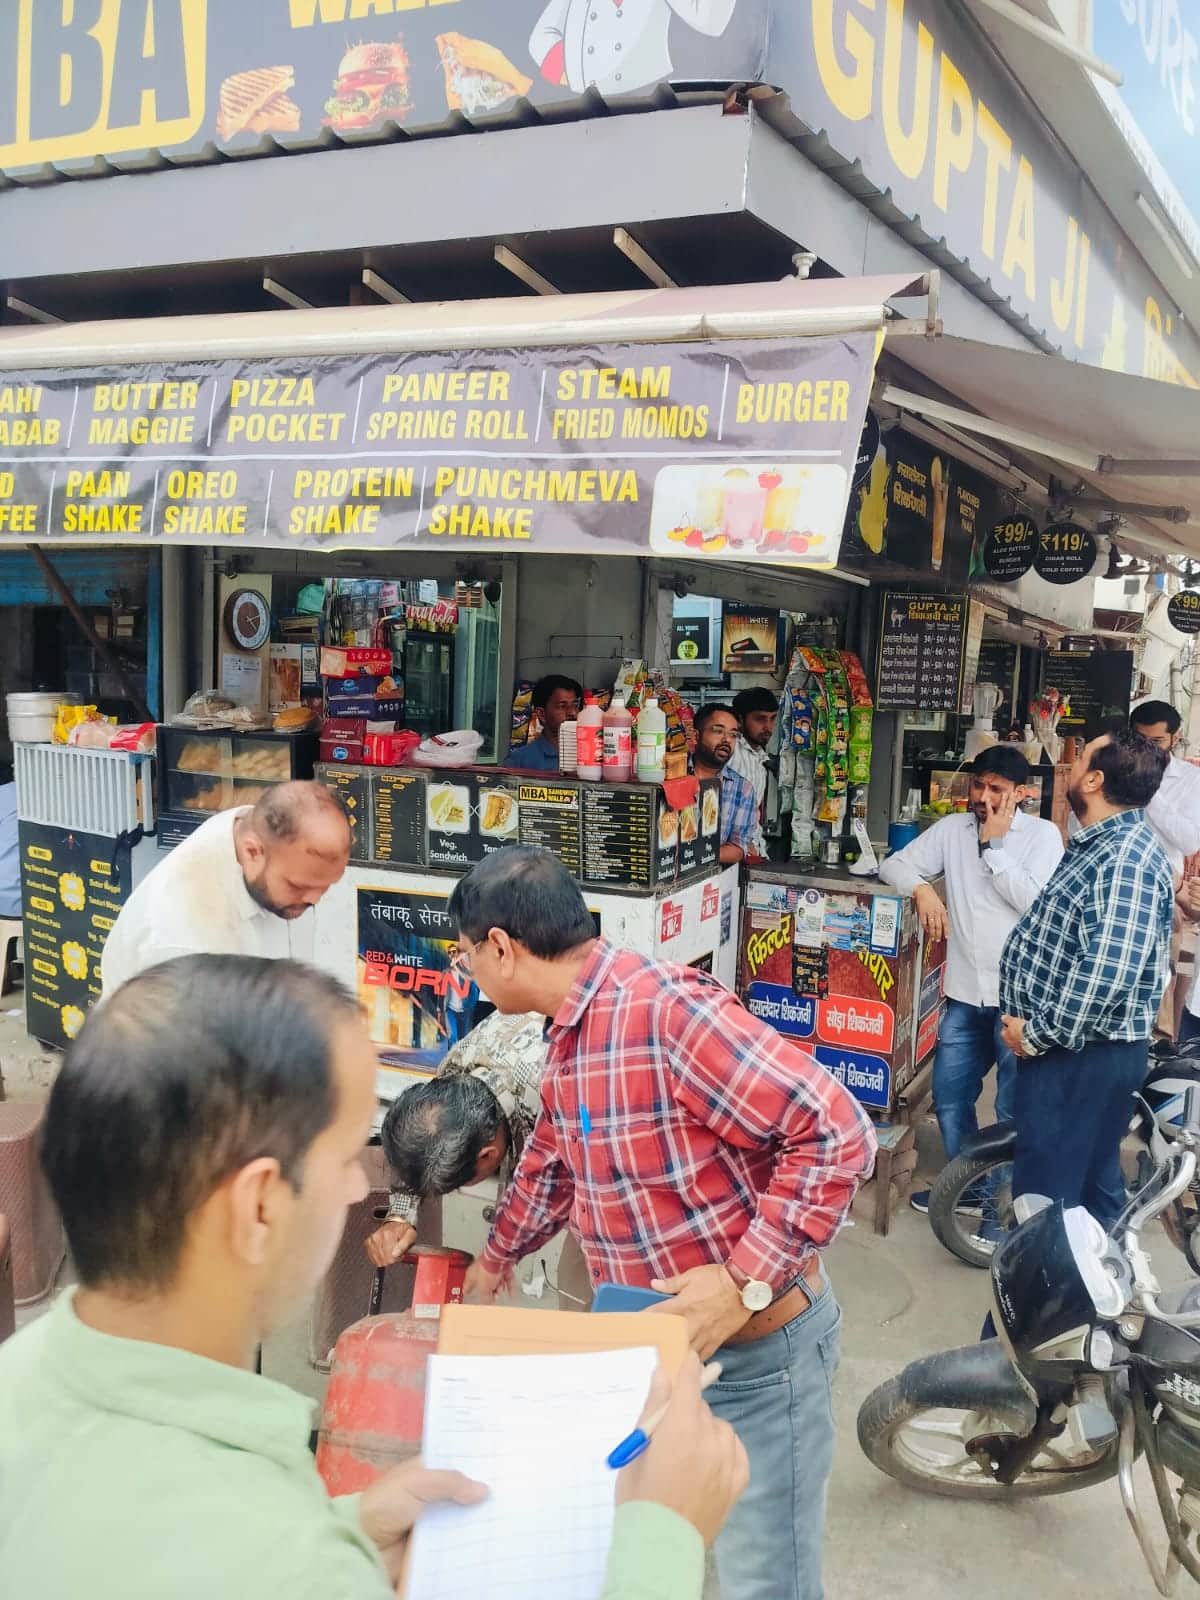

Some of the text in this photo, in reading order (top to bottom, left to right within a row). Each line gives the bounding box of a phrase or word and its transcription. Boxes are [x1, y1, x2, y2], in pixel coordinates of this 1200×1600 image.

[812, 0, 1036, 301] GUPTA
[1051, 216, 1090, 349] JI
[93, 382, 199, 412] BUTTER
[230, 378, 315, 408] PIZZA
[382, 370, 511, 403] PANEER
[557, 366, 671, 401] STEAM
[736, 380, 849, 423] BURGER
[88, 416, 195, 445] MAGGIE
[227, 413, 346, 443] POCKET
[366, 409, 529, 440] SPRING ROLL
[552, 404, 710, 440] FRIED MOMOS
[66, 470, 131, 498] PAAN
[167, 470, 237, 499] OREO
[293, 467, 414, 499] PROTEIN
[434, 467, 639, 502] PUNCHMEVA
[63, 504, 143, 533] SHAKE
[163, 506, 247, 534] SHAKE
[288, 505, 381, 535] SHAKE
[428, 504, 534, 539] SHAKE
[993, 521, 1034, 544] ₹99/-
[1041, 532, 1089, 552] ₹119/-
[909, 602, 961, 611] GUPTA JI
[521, 788, 545, 799] MBA
[430, 852, 468, 862] Sandwich
[439, 839, 457, 849] Veg.
[370, 900, 414, 929] तंबाकू
[364, 963, 471, 998] BORN
